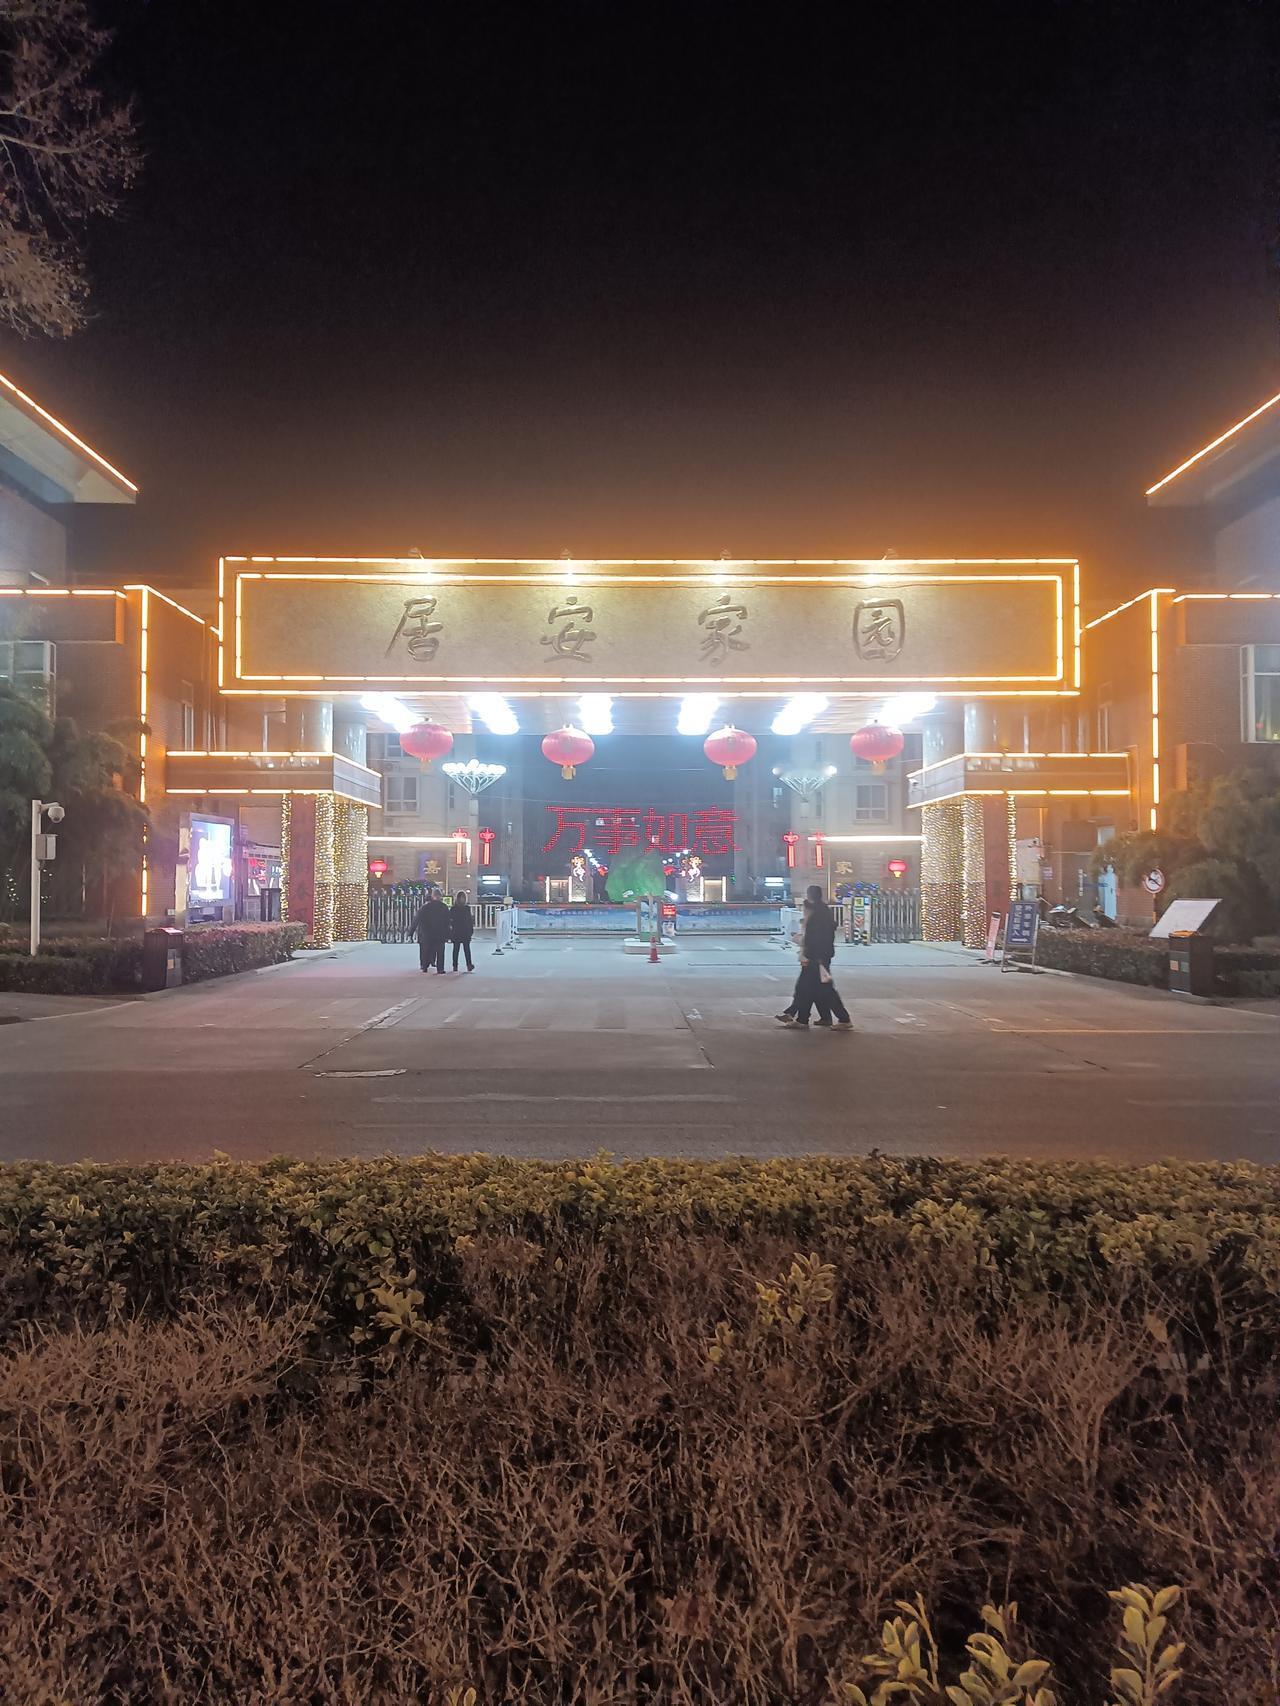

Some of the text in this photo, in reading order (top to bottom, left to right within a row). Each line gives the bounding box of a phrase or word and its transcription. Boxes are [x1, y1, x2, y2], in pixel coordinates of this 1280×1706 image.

[385, 593, 906, 667] 居安家园
[541, 805, 744, 856] 万事如意
